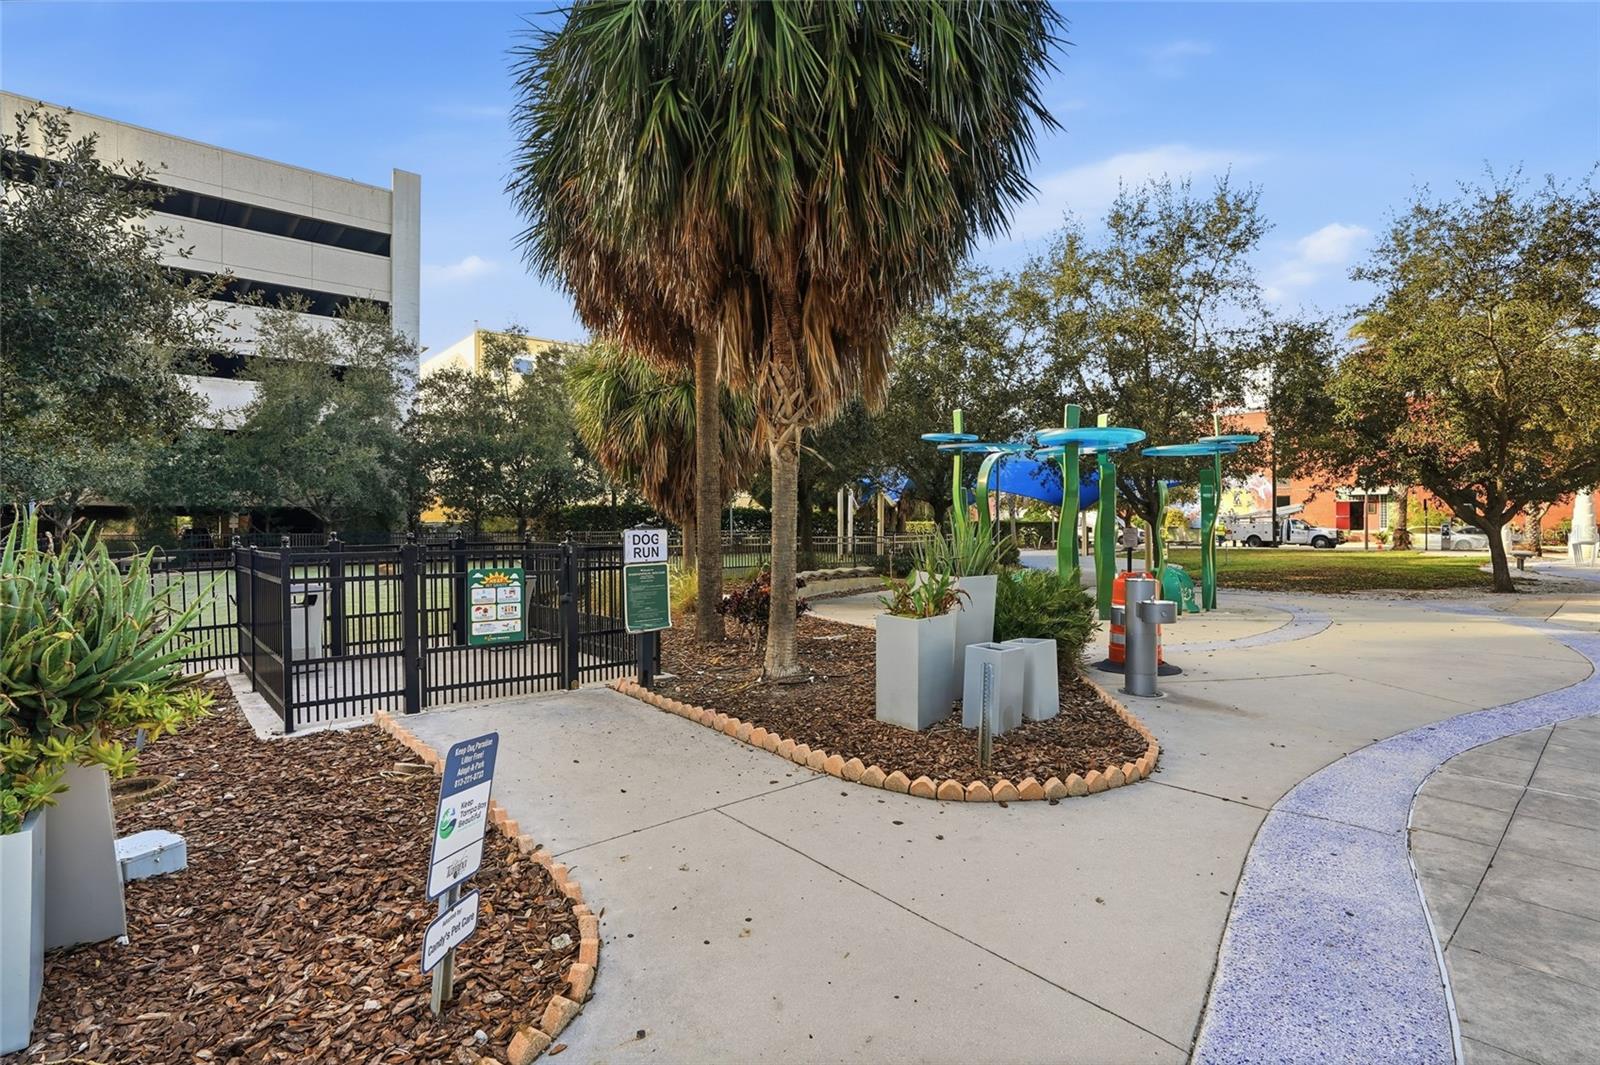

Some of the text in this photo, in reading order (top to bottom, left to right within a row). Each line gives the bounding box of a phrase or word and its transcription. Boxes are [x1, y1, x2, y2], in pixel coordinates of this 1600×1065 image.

[633, 534, 659, 545] DOG
[633, 546, 659, 558] RUN
[455, 747, 467, 757] Keep
[461, 756, 473, 765] Litter
[457, 760, 485, 776] Adopt-A-Park
[460, 799, 474, 809] Keep
[460, 801, 486, 818] Tampa Bay
[458, 810, 482, 828] Beautiful
[428, 912, 475, 957] Candy's Pet Care
